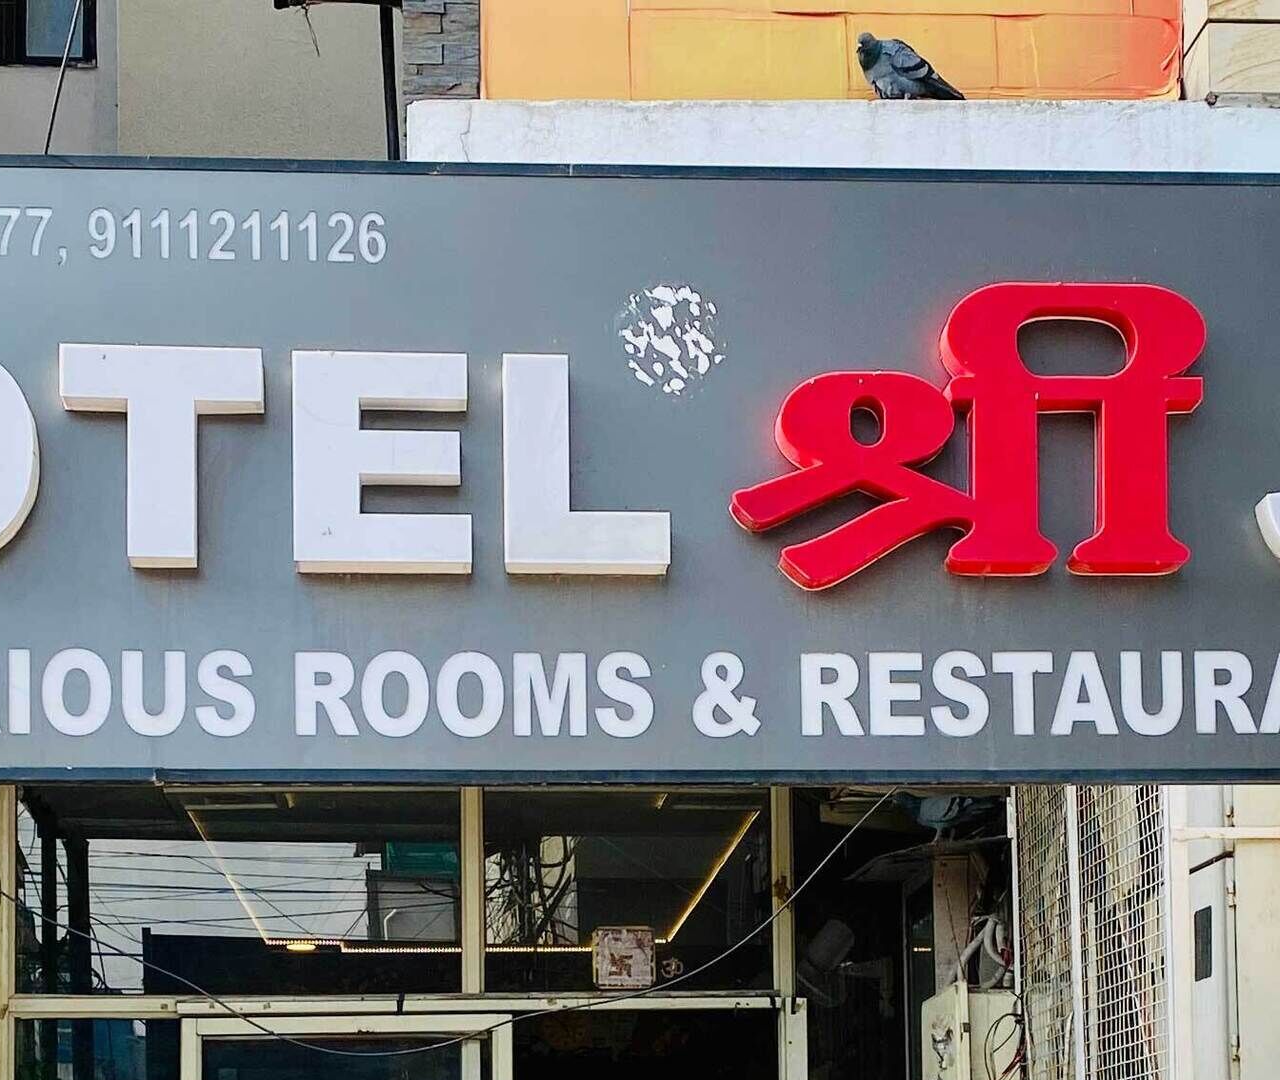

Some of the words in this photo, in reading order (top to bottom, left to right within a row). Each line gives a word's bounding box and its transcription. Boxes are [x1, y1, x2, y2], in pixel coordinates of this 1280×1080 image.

[87, 208, 388, 264] 9111211126
[730, 281, 1207, 592] श्री
[294, 651, 656, 738] ROOMS
[692, 651, 762, 738] &
